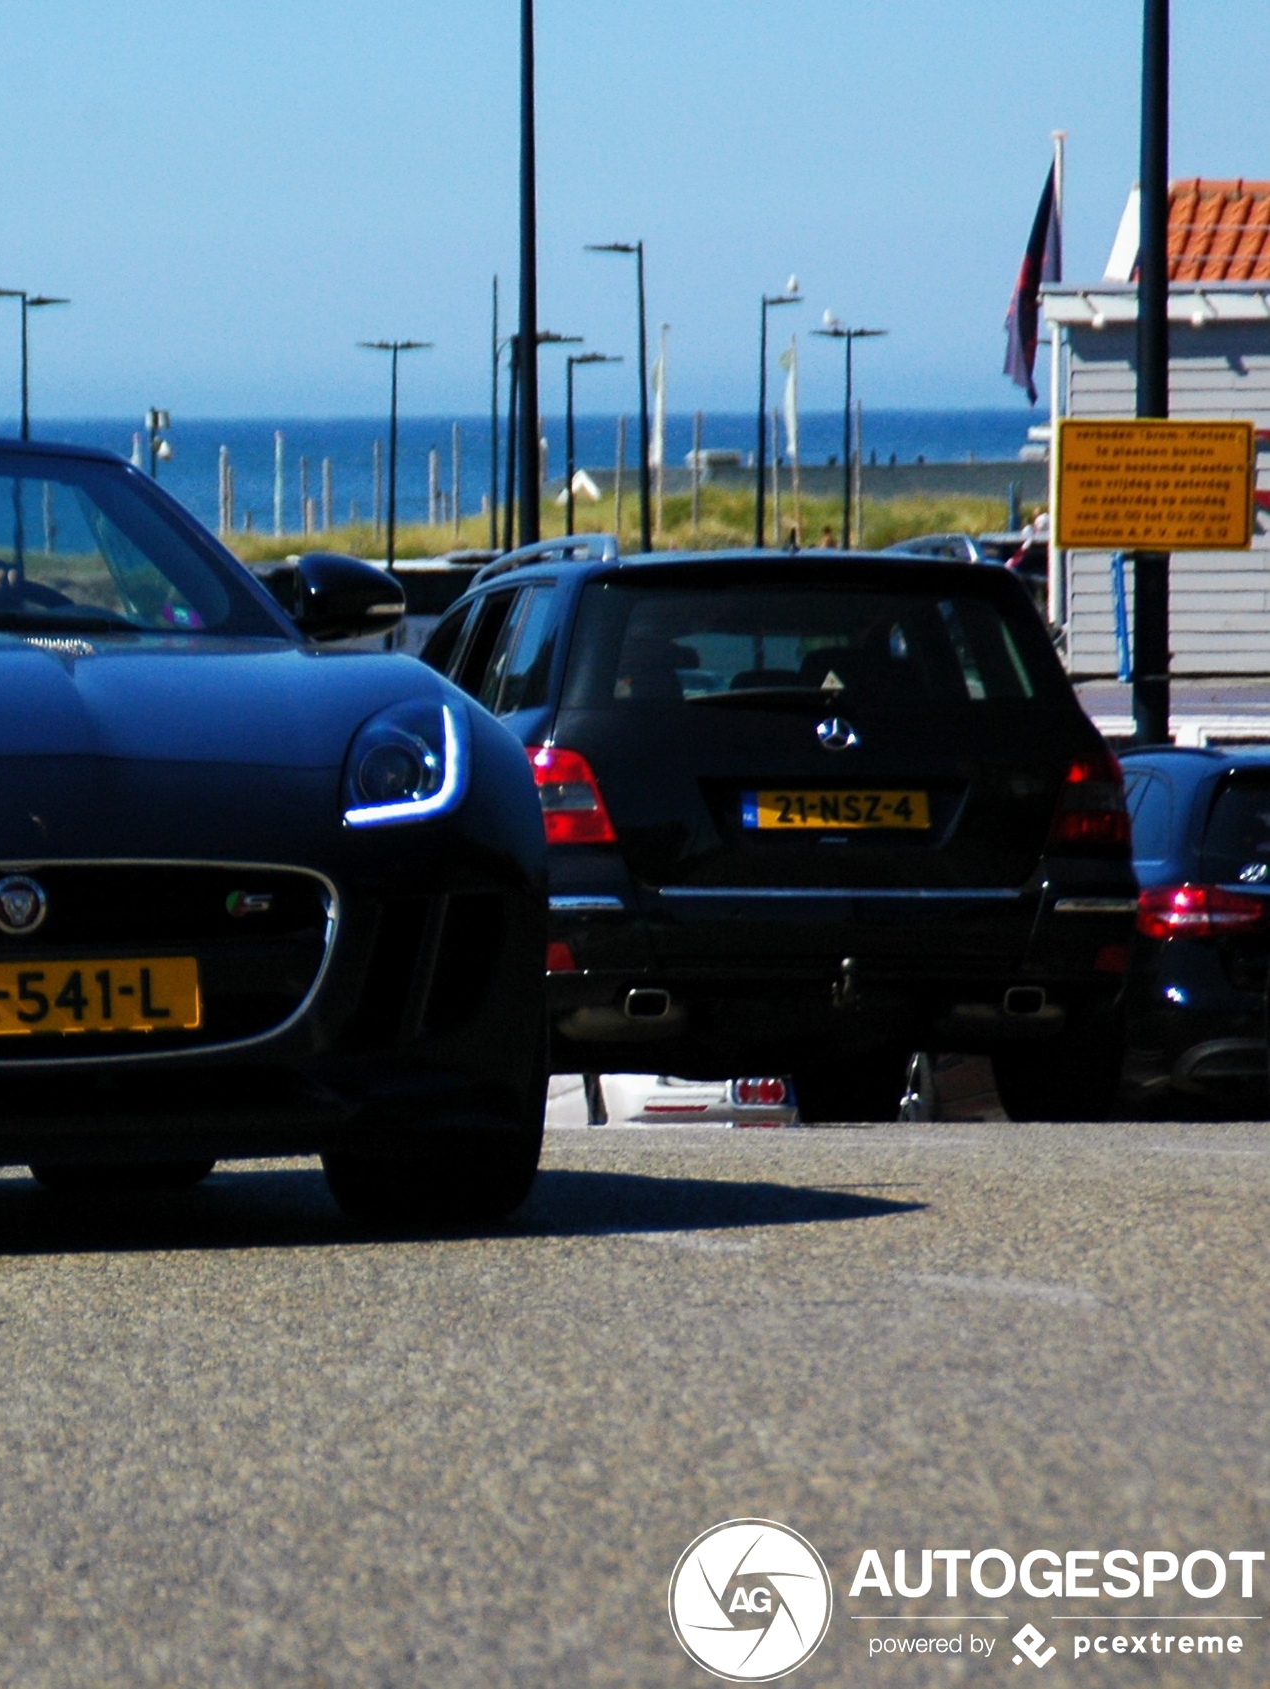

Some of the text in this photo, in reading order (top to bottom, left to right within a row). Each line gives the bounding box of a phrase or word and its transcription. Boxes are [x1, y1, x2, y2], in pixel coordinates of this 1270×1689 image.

[1076, 430, 1134, 441] verboden
[1096, 445, 1215, 458] te plaatsen buiten
[1065, 462, 1121, 473] daarvoor
[1124, 462, 1186, 473] bestemde
[1078, 478, 1231, 492] van vrijdag op zaterdag
[1081, 494, 1226, 507] en zaterdag op zondag
[1075, 511, 1100, 521] van
[1144, 511, 1163, 522] tot
[1208, 511, 1232, 522] uur
[1070, 527, 1124, 538] conform
[775, 795, 914, 823] 21-NSZ-4
